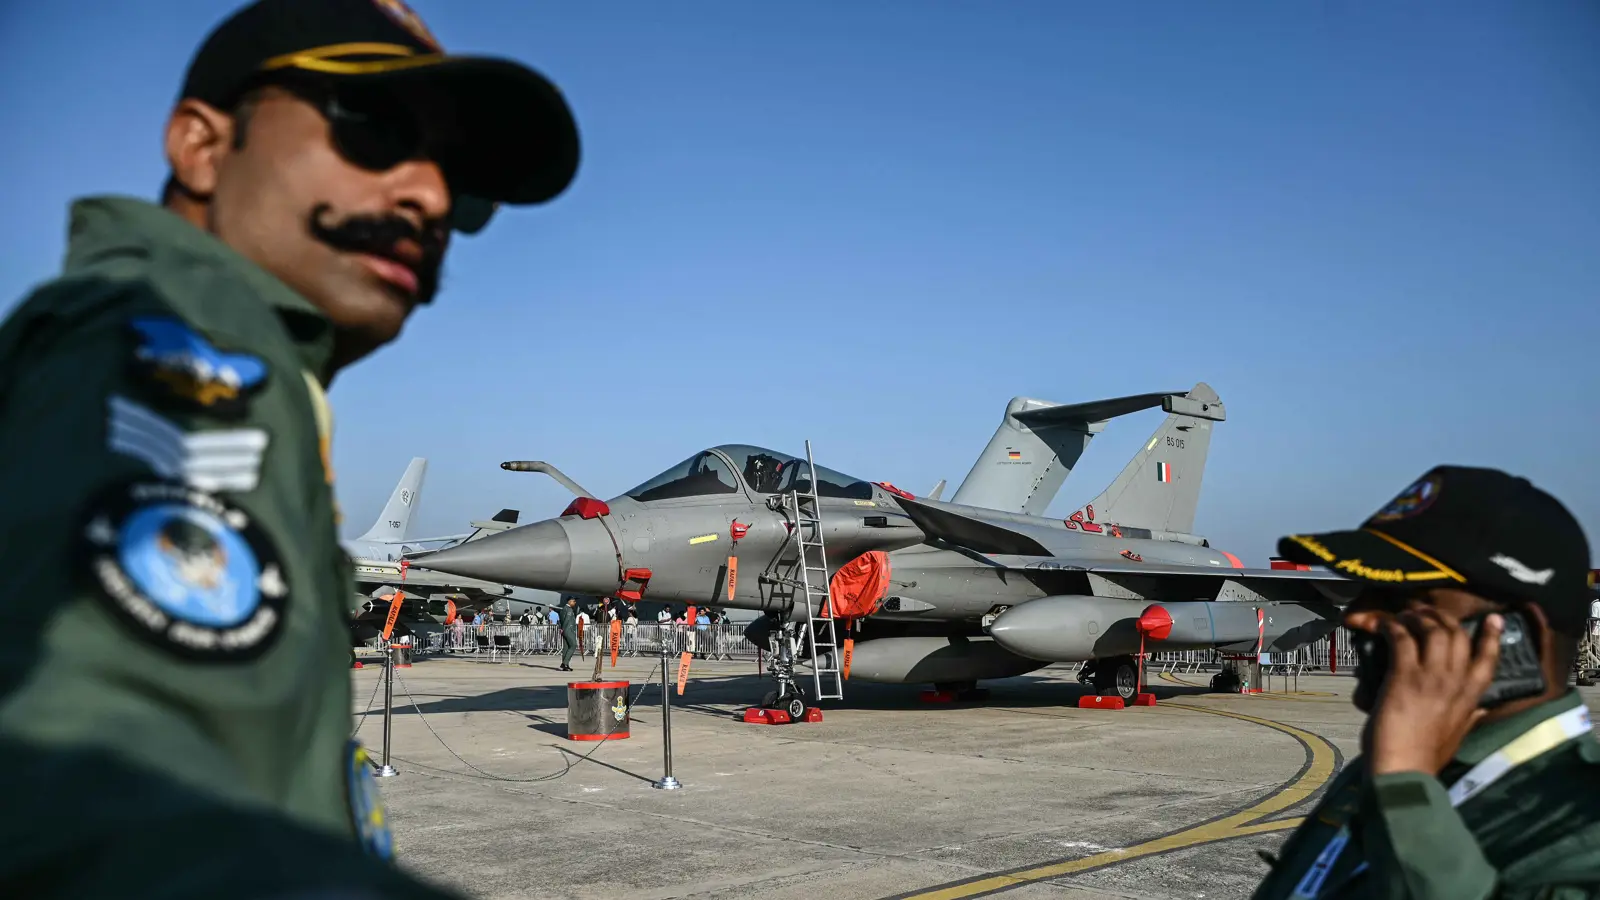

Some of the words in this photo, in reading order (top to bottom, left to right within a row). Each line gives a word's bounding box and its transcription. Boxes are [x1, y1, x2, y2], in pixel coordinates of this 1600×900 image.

[1166, 437, 1174, 446] BS
[1175, 438, 1185, 449] 015
[611, 632, 619, 651] RAFALE
